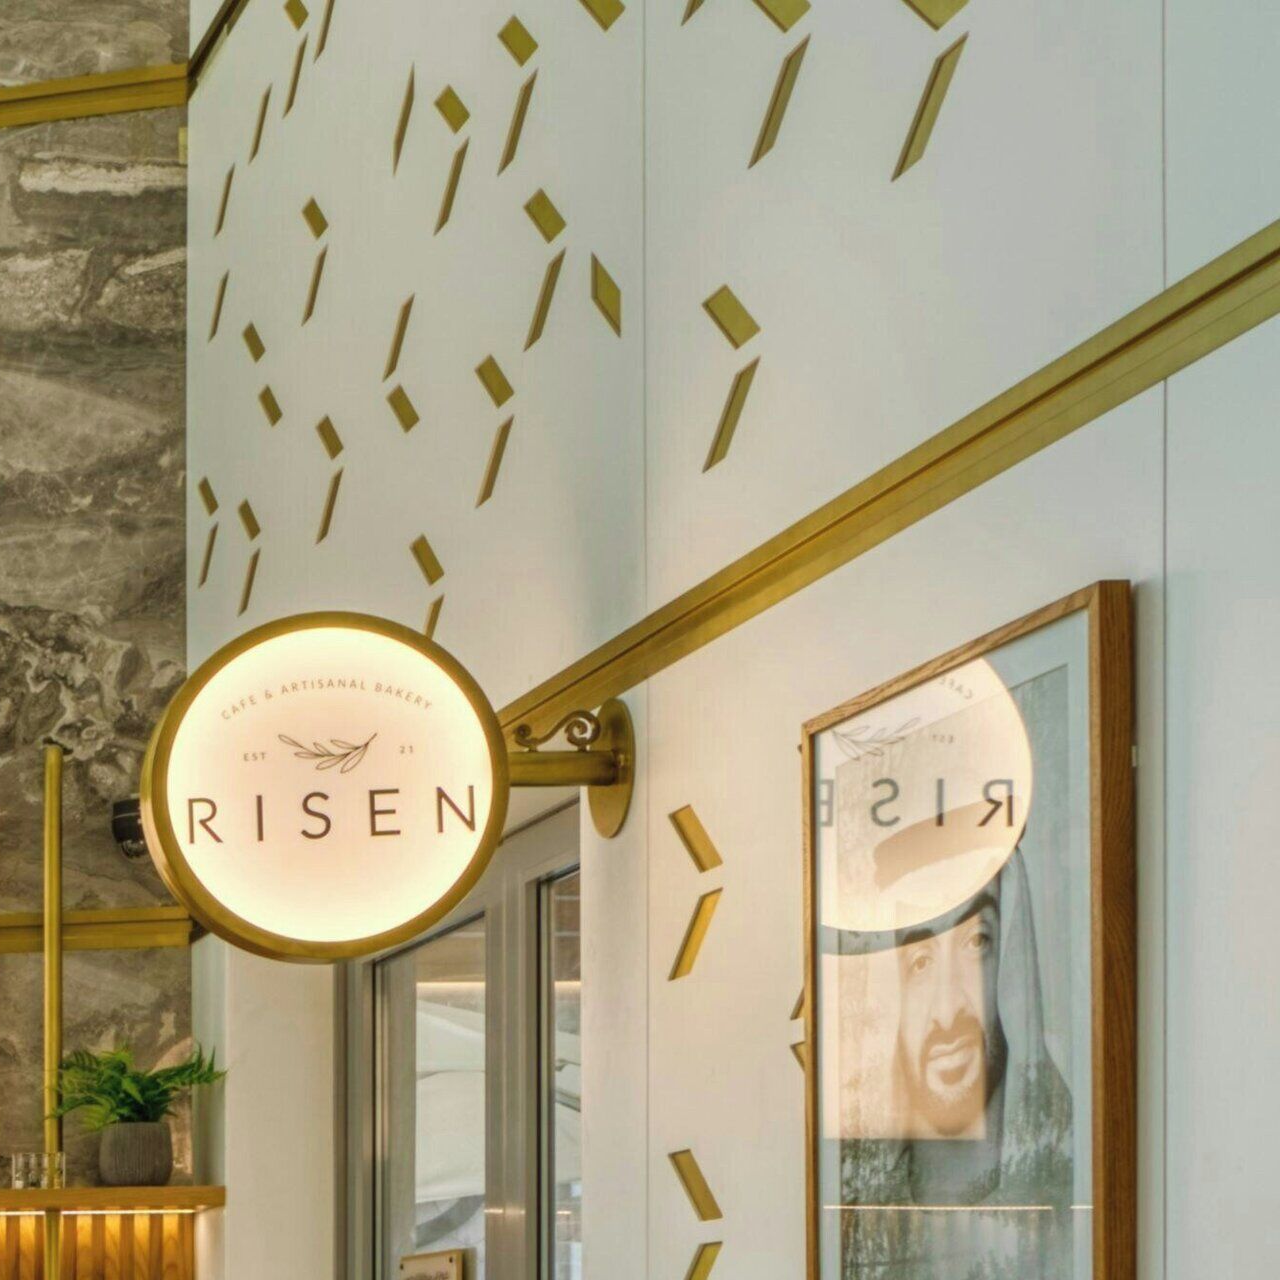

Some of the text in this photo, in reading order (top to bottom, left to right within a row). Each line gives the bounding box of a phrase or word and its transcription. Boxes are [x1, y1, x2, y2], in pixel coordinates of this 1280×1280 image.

[220, 677, 433, 721] CAFE & ARTISANAL BAKERY
[243, 744, 415, 762] EST 21
[187, 784, 477, 845] RISEN
